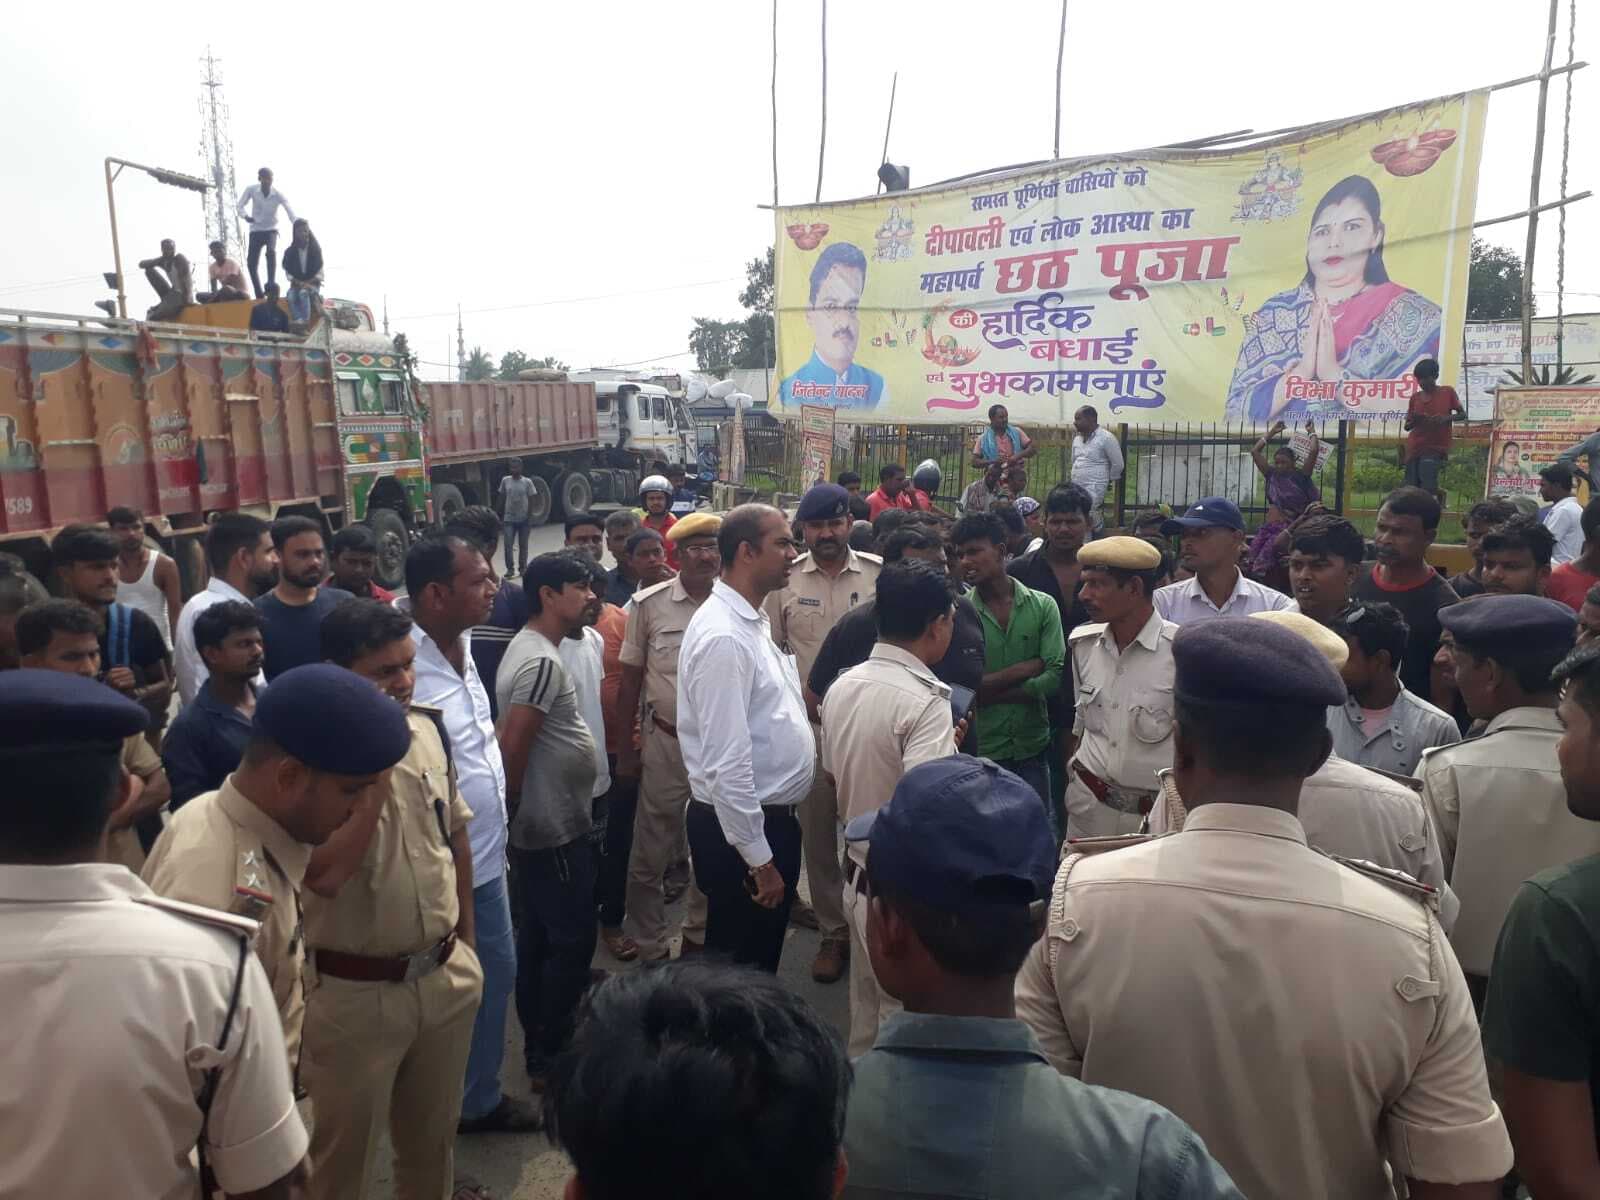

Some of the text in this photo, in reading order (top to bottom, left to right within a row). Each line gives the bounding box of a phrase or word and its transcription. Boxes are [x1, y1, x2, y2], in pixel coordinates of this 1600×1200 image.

[971, 191, 1009, 211] समस्त
[1065, 167, 1119, 194] वासियों
[1123, 166, 1148, 187] को
[925, 208, 1195, 257] दीपावली एवं लोक आस्था का
[920, 236, 1241, 302] महापर्व छठ पूजा
[952, 291, 1096, 351] की हार्दिक
[1029, 328, 1139, 365] बधाई
[927, 359, 1167, 415] शुभकामनाएं
[1285, 376, 1338, 401] विभा
